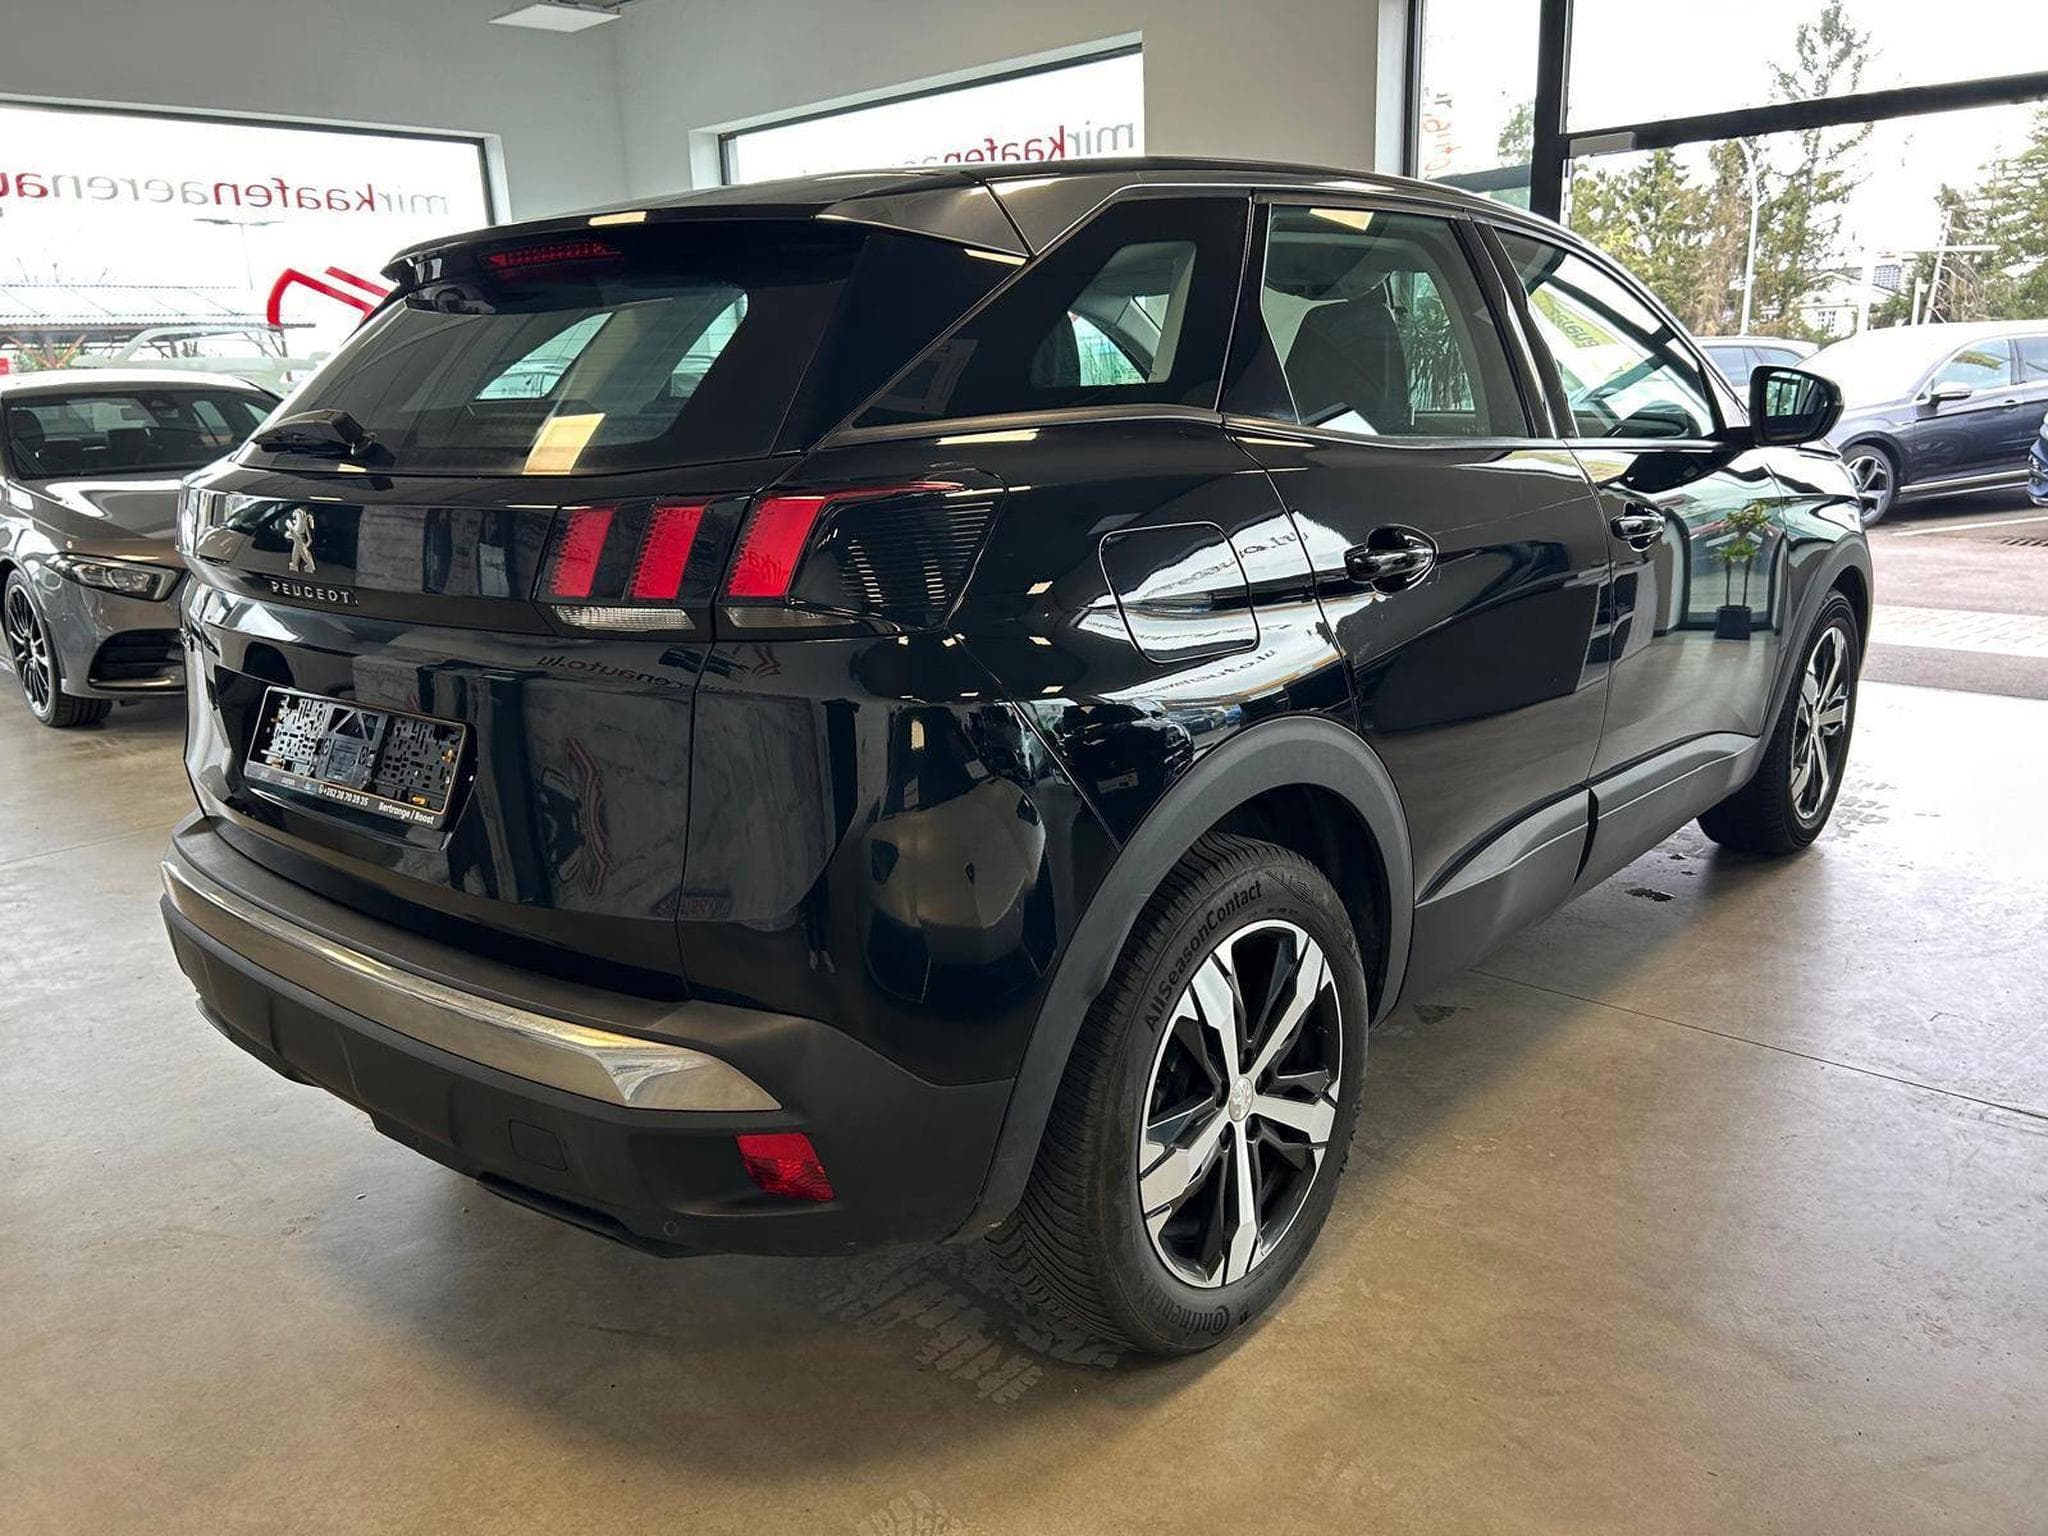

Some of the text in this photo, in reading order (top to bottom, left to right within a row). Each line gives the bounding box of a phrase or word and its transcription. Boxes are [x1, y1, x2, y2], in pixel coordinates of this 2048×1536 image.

[271, 581, 349, 603] PEUGEOT
[378, 802, 410, 819] Bertrange
[1143, 880, 1263, 1032] AllSeasonContact
